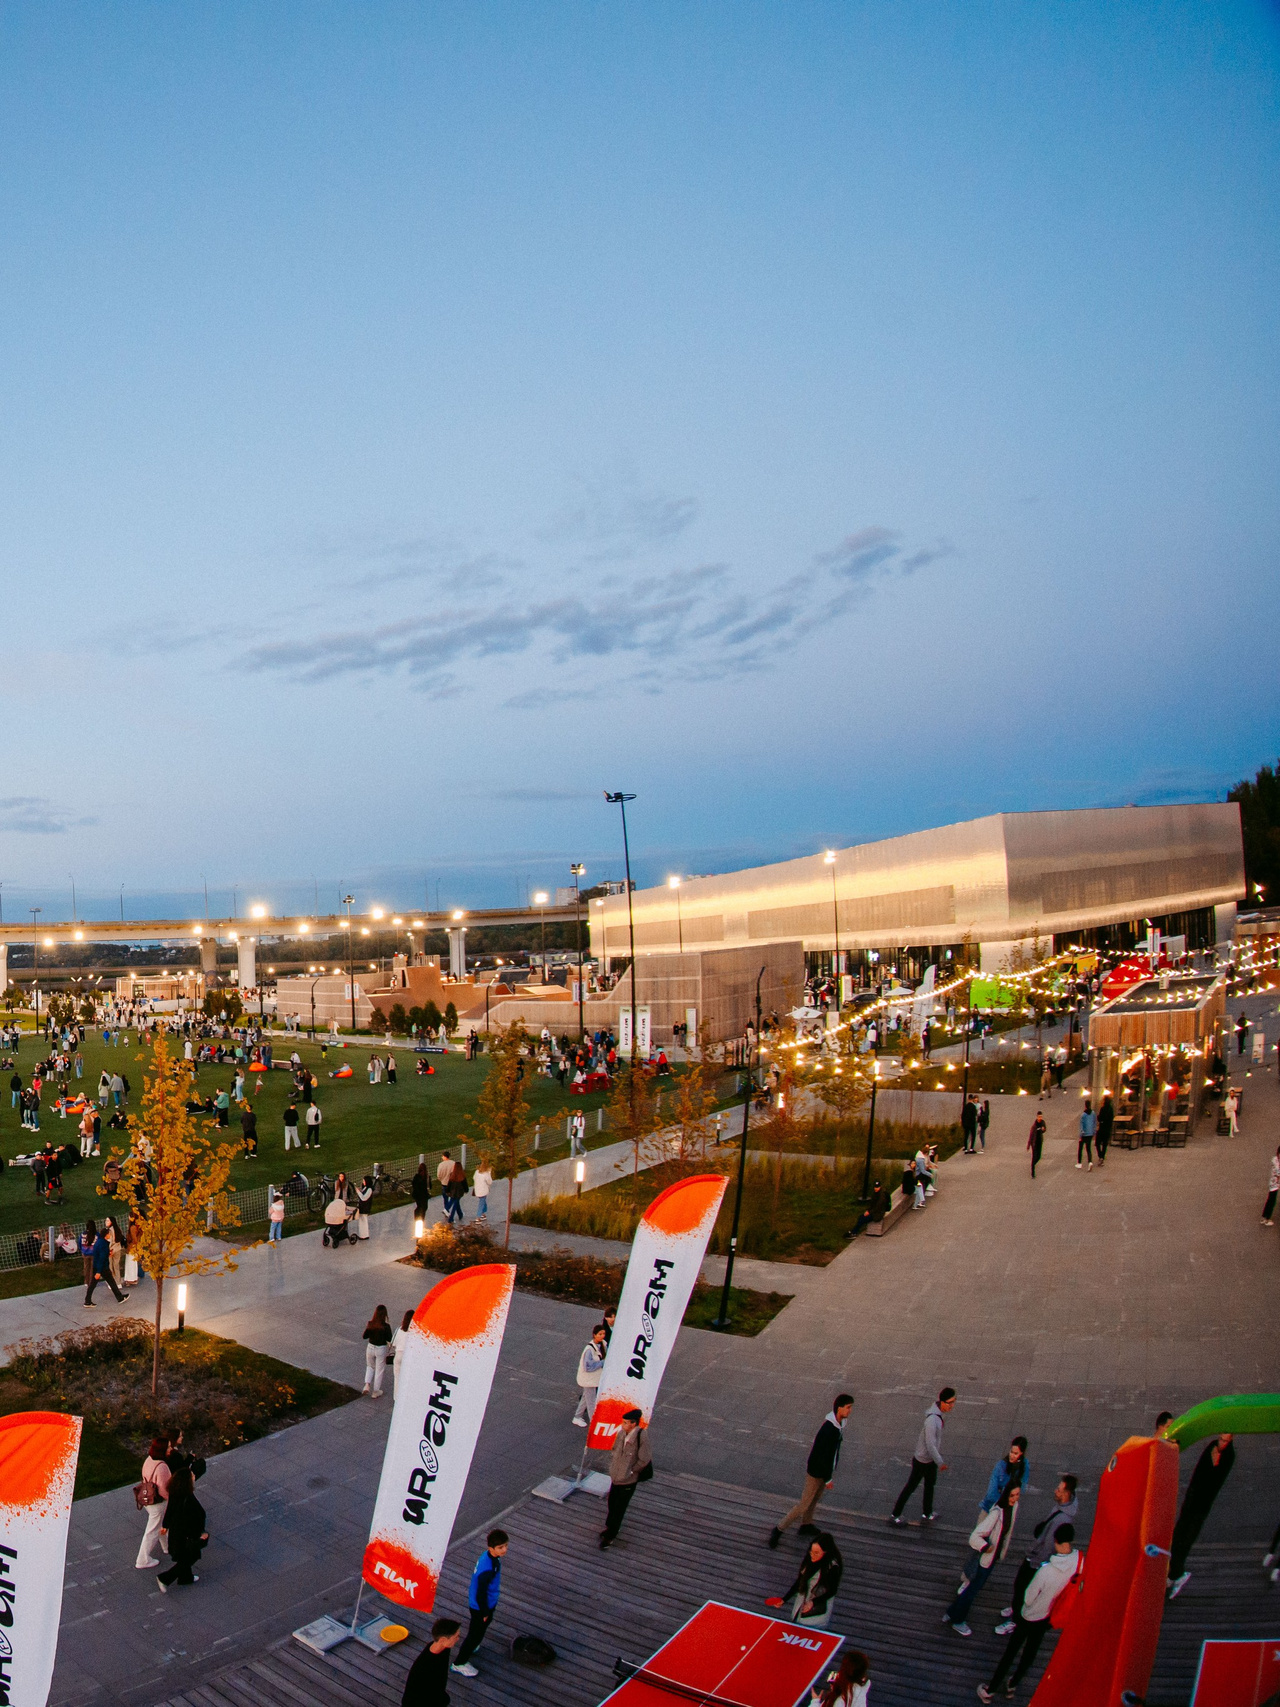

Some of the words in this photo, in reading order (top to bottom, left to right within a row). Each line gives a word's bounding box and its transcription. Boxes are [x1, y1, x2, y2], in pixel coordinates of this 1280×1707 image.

[593, 1422, 623, 1437] ПИ
[421, 1445, 437, 1470] FEST
[373, 1561, 419, 1599] ПИК
[777, 1631, 822, 1652] ПИК
